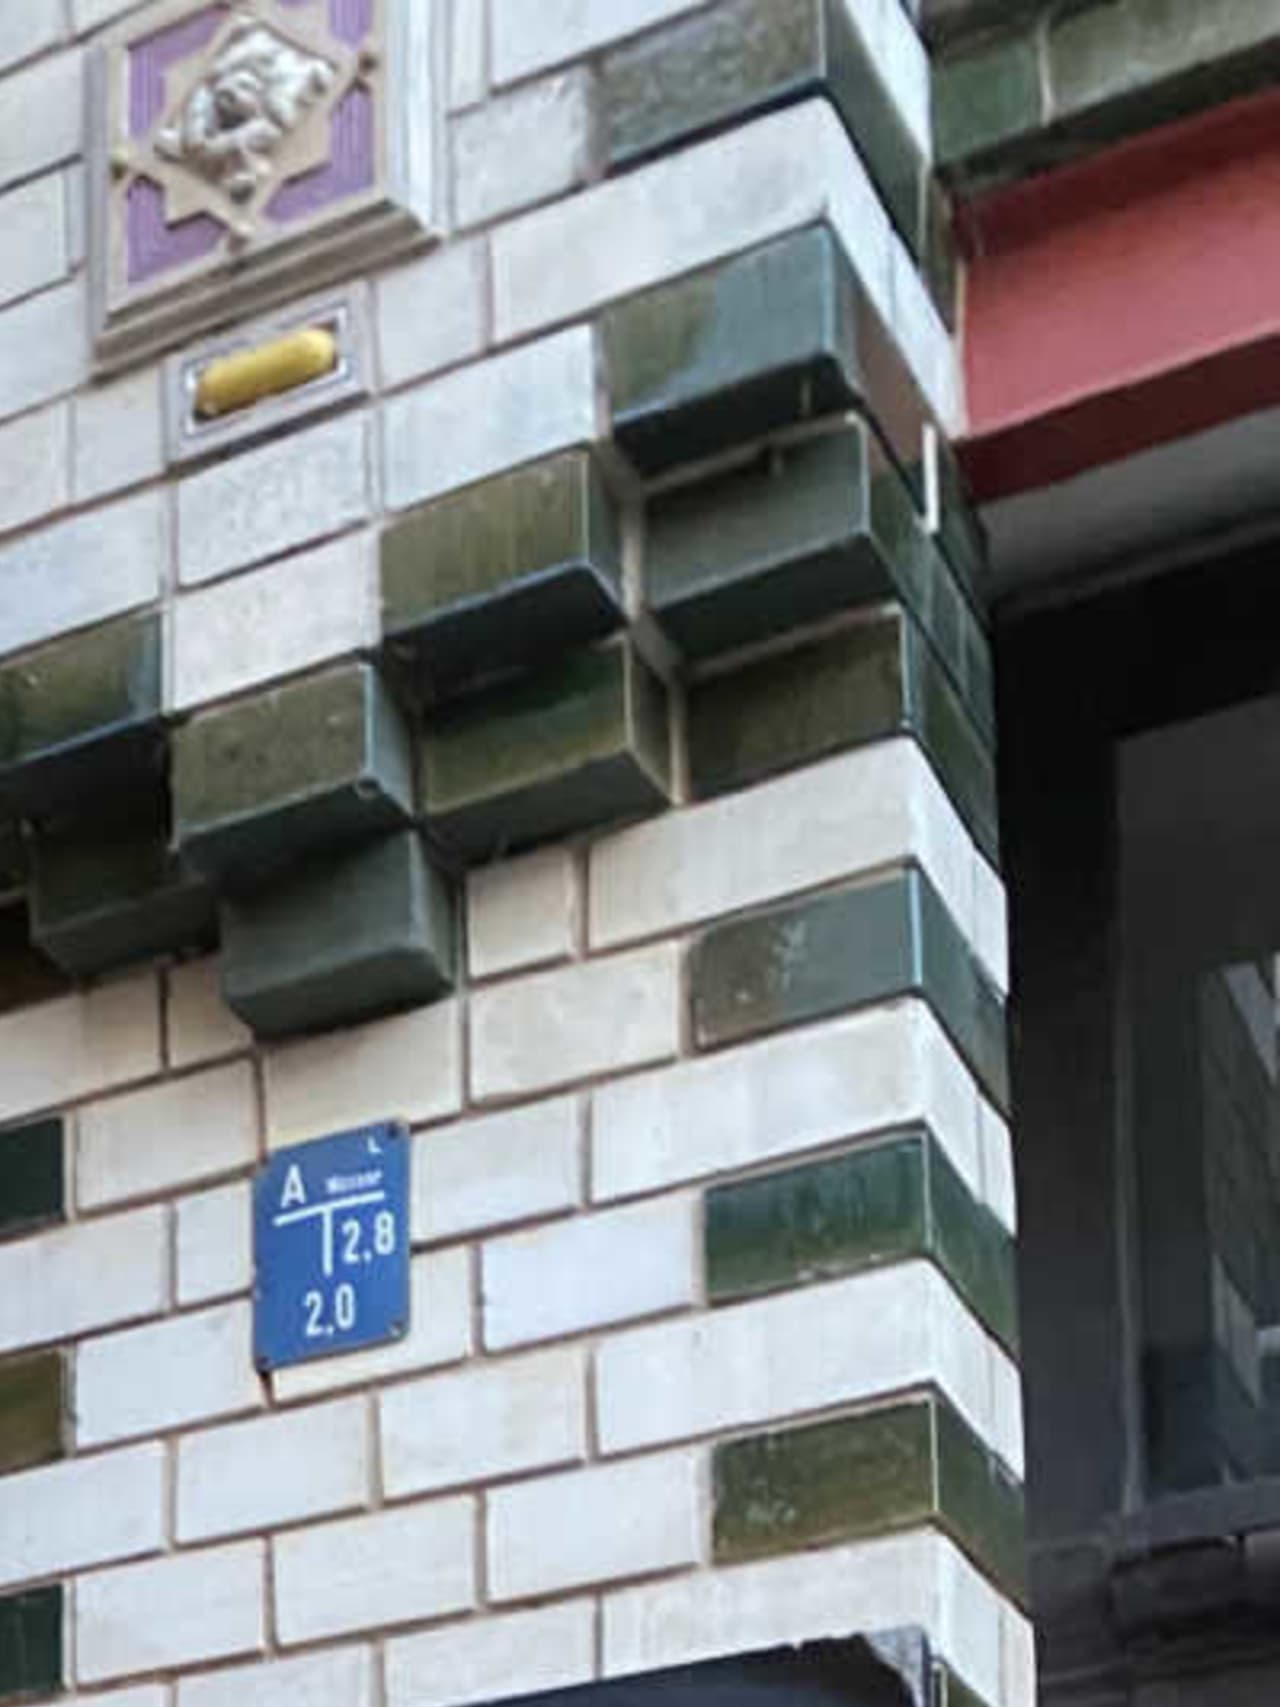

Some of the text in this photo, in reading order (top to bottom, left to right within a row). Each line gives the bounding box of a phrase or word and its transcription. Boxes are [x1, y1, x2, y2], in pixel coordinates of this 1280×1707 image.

[280, 1163, 307, 1209] A
[341, 1210, 396, 1264] 2.8
[304, 1283, 355, 1337] 2.0
